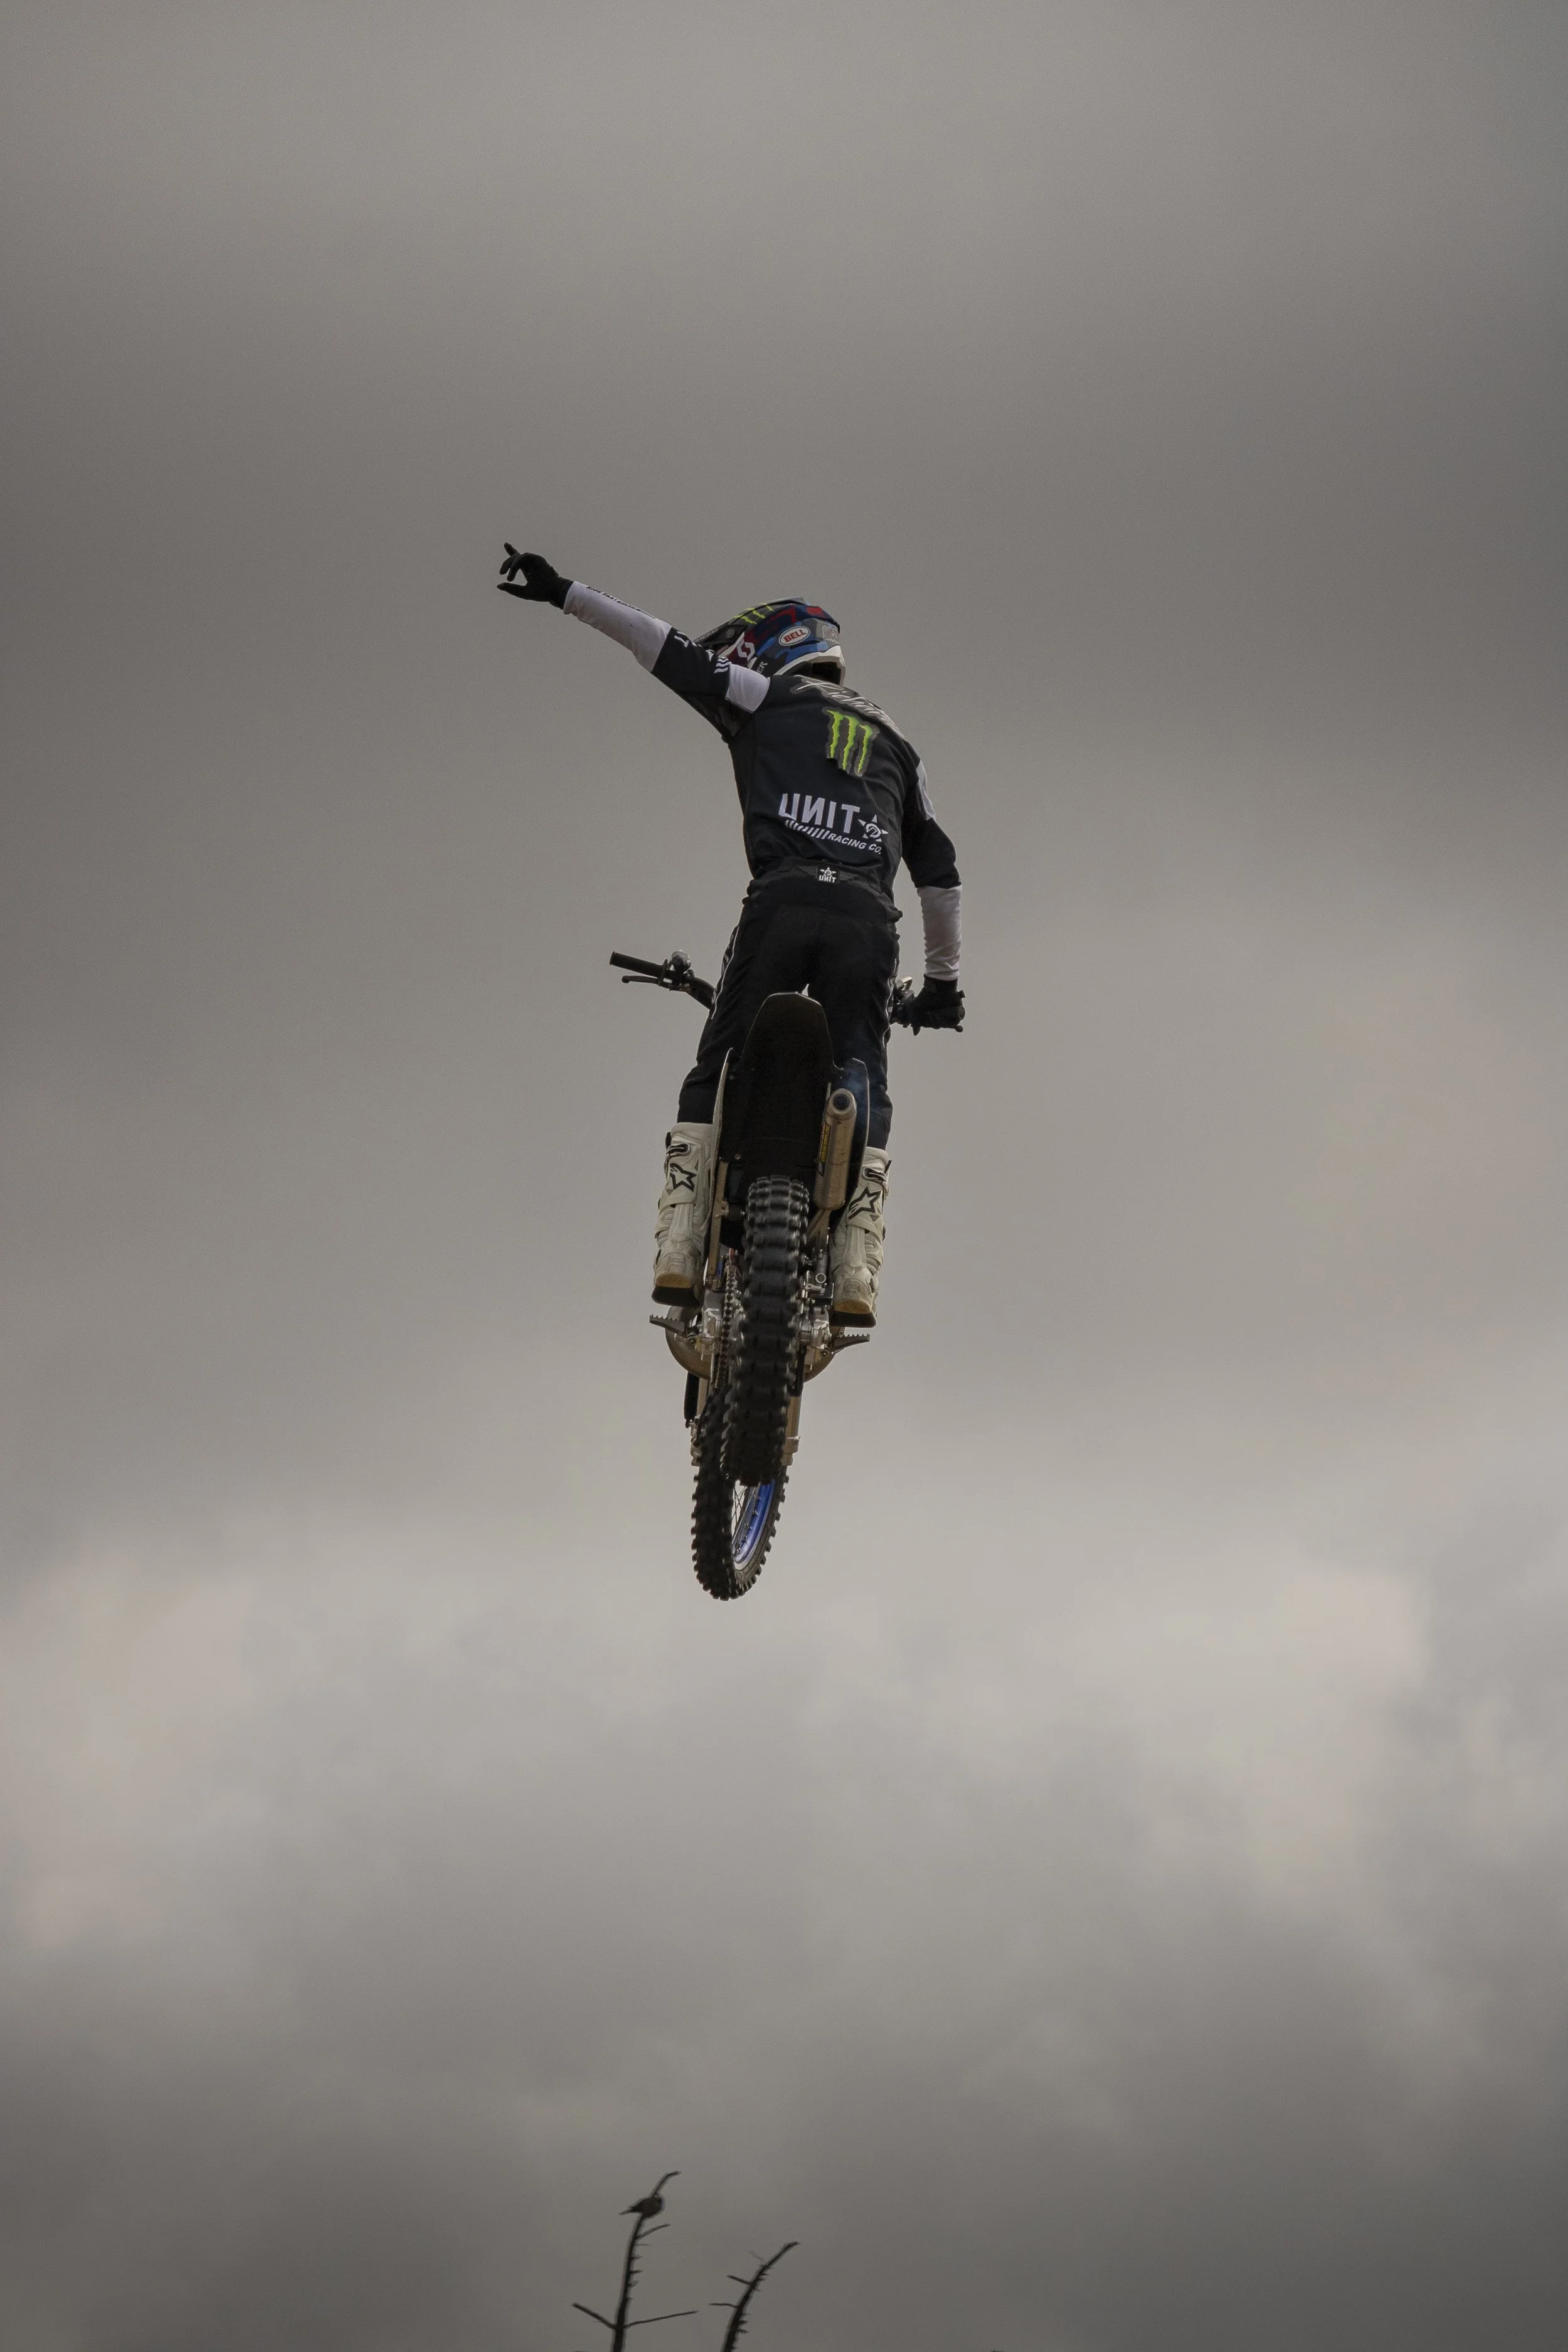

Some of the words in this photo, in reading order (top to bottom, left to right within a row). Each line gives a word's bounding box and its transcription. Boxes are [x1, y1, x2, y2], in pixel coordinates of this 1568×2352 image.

[783, 629, 806, 643] BELL
[827, 833, 867, 850] RACING
[868, 844, 882, 855] CO.
